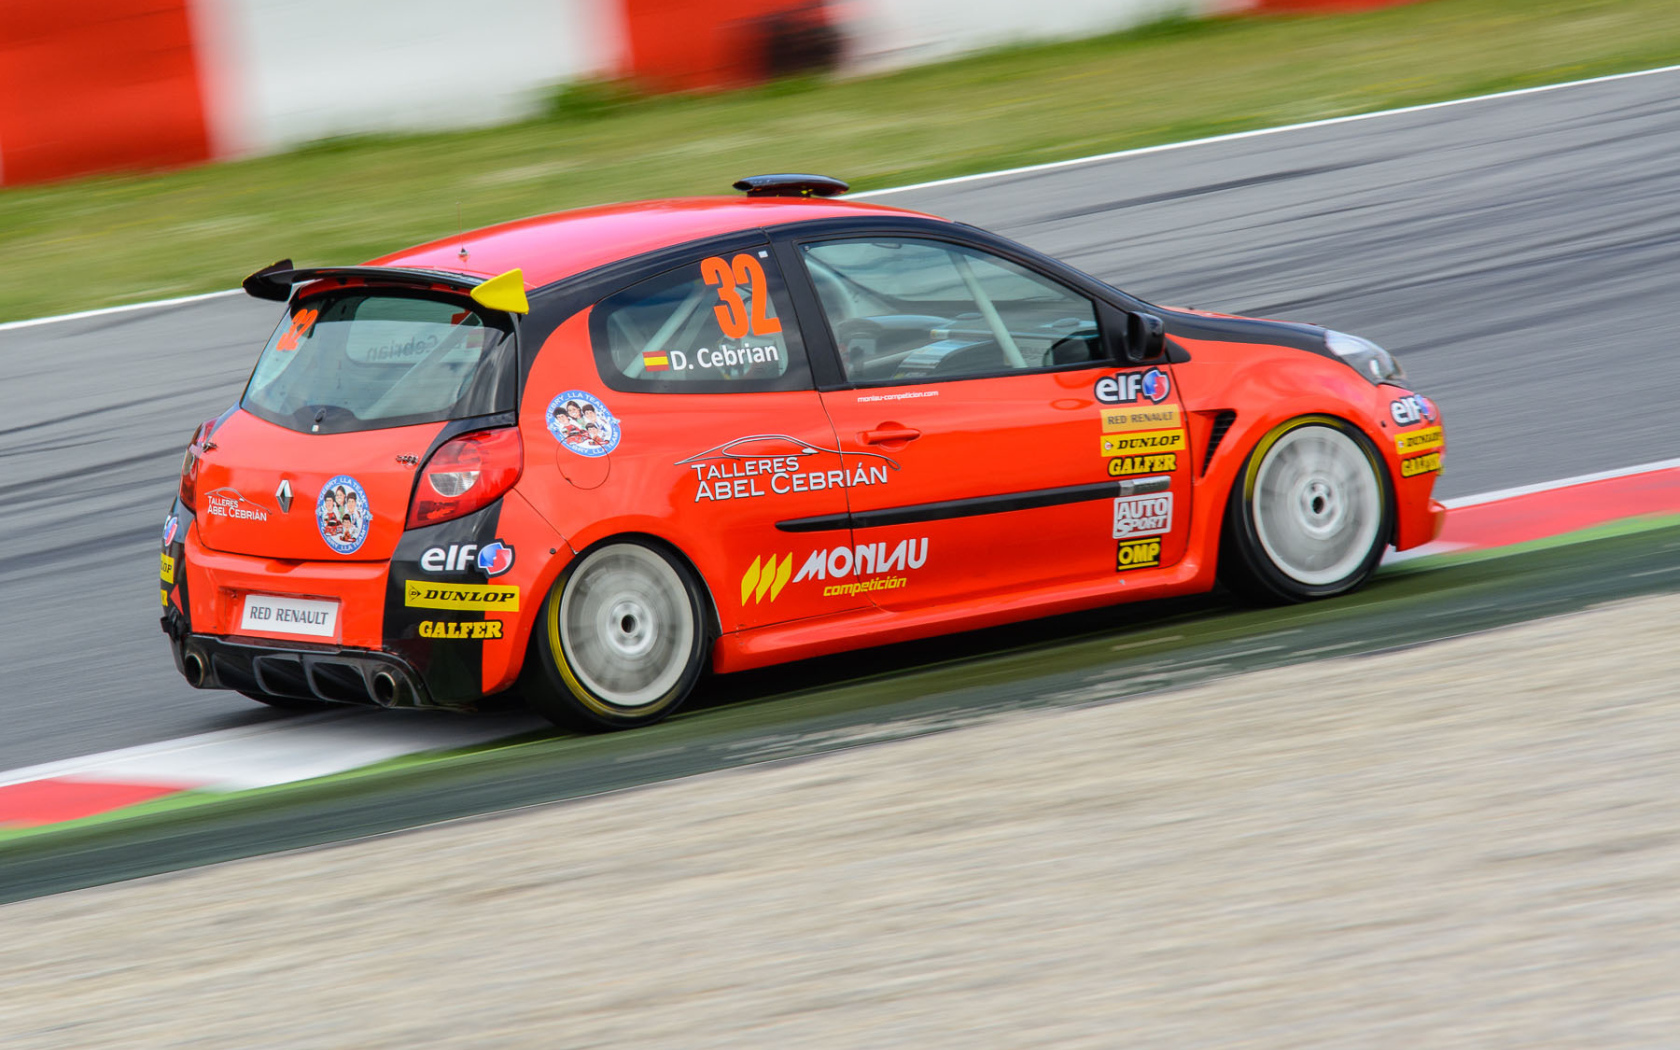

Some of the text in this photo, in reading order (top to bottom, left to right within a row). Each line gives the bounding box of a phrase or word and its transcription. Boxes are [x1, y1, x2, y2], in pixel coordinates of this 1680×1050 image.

[701, 253, 782, 339] 32
[276, 308, 318, 351] 32
[670, 343, 779, 371] D. Cebrian
[1095, 374, 1142, 402] elf
[1107, 411, 1174, 425] RED RENAULT
[1391, 396, 1421, 424] elf
[1117, 435, 1180, 450] DUNLOP
[691, 456, 800, 481] TALLERES
[1108, 453, 1177, 476] GALFER
[695, 463, 888, 503] ABEL CEBRIÁN
[208, 496, 239, 508] TALLERES
[208, 504, 267, 521] ABEL CEBRIÁN
[1118, 498, 1168, 520] AUTO
[1116, 515, 1167, 535] SPORT
[421, 544, 478, 572] elf
[792, 537, 929, 583] MONLAU
[1118, 542, 1160, 565] OMP
[424, 589, 515, 602] DUNLOP
[823, 576, 907, 597] competición
[250, 606, 328, 625] RED RENAULT
[418, 620, 502, 639] GALFER
